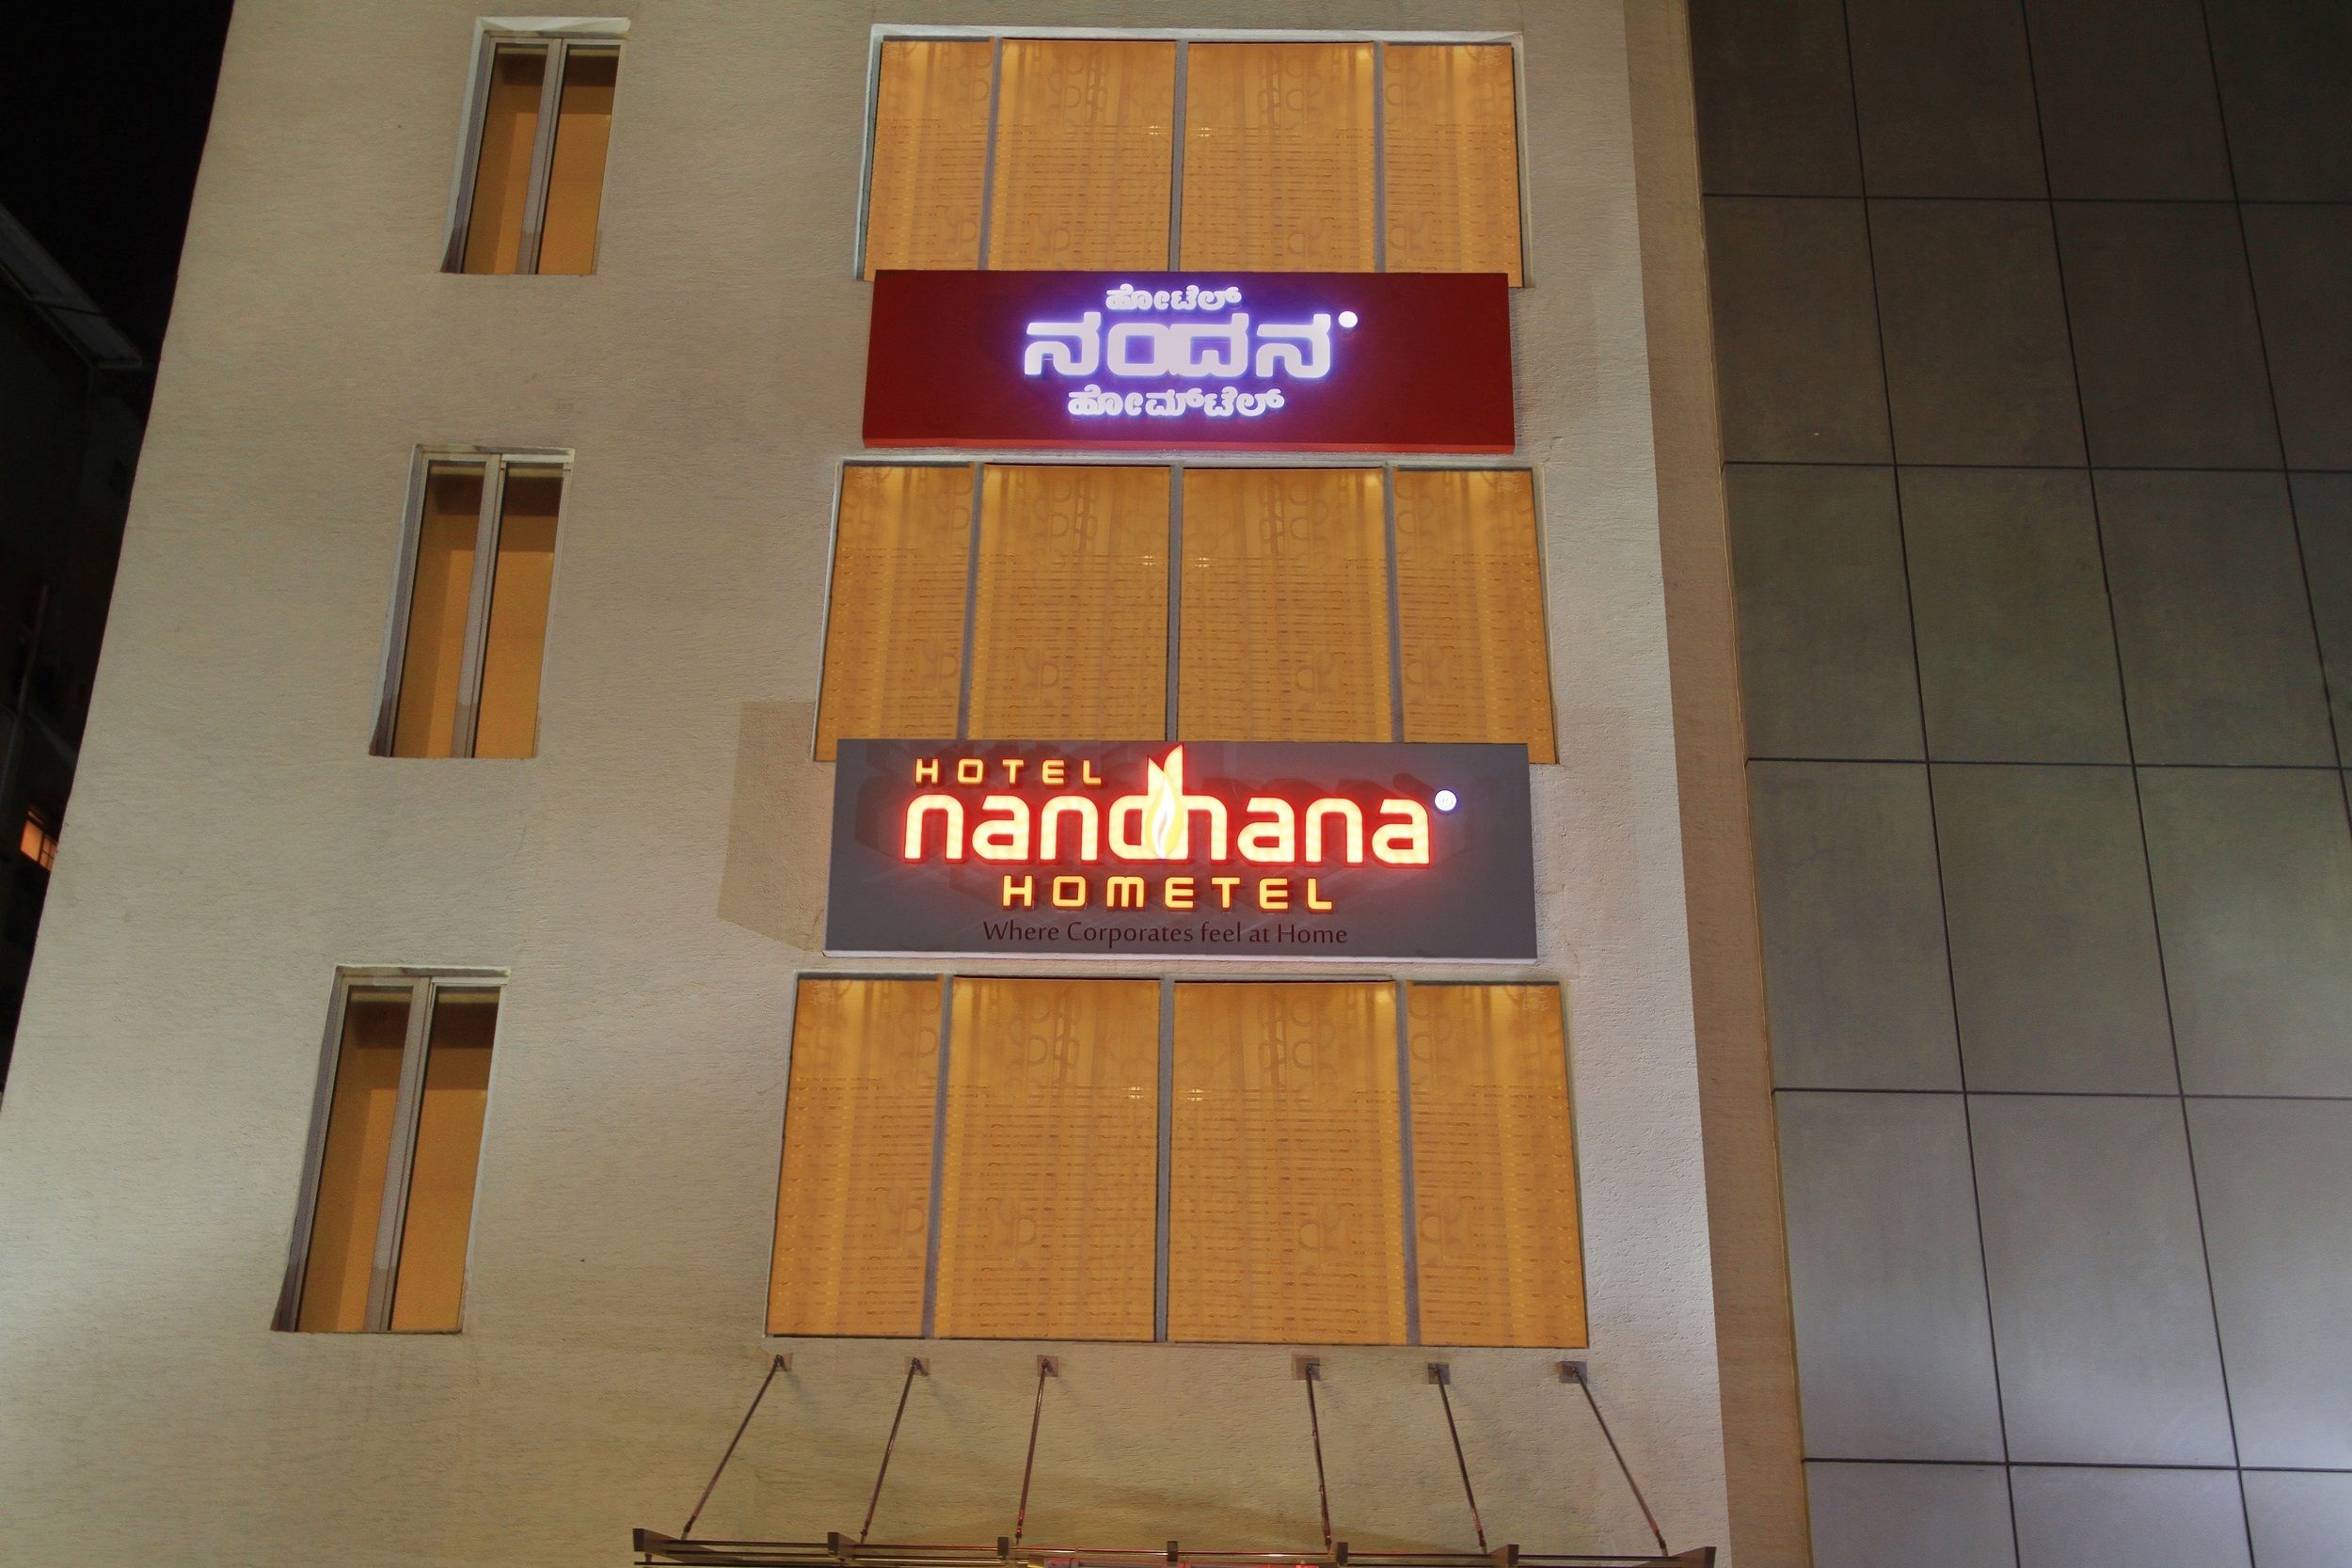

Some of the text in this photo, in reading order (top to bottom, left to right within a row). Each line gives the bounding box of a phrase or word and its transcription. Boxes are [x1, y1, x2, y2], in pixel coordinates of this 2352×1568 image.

[1105, 283, 1242, 310] ಹೋಟೆಲ್
[1024, 311, 1331, 377] ನಂದನ
[915, 758, 1103, 785] HOTEL
[904, 746, 1431, 864] nandhana
[1002, 875, 1333, 911] HOMETEL
[983, 919, 1349, 948] Where Corporates feel at Home
